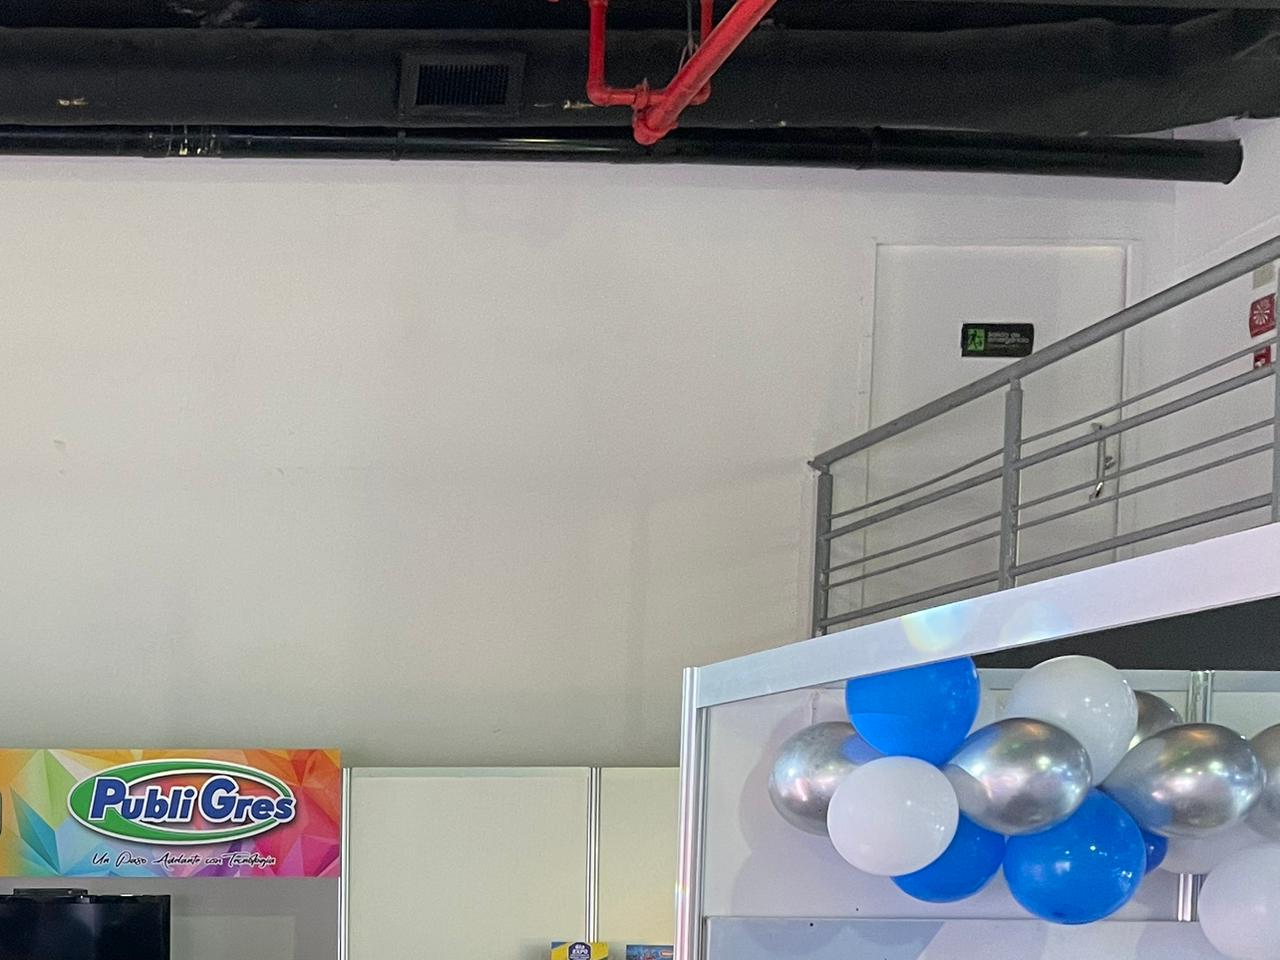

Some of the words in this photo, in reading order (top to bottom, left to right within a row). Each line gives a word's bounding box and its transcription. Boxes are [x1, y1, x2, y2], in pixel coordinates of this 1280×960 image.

[89, 777, 196, 821] Publi
[200, 776, 295, 822] Gres
[92, 853, 110, 865] Un
